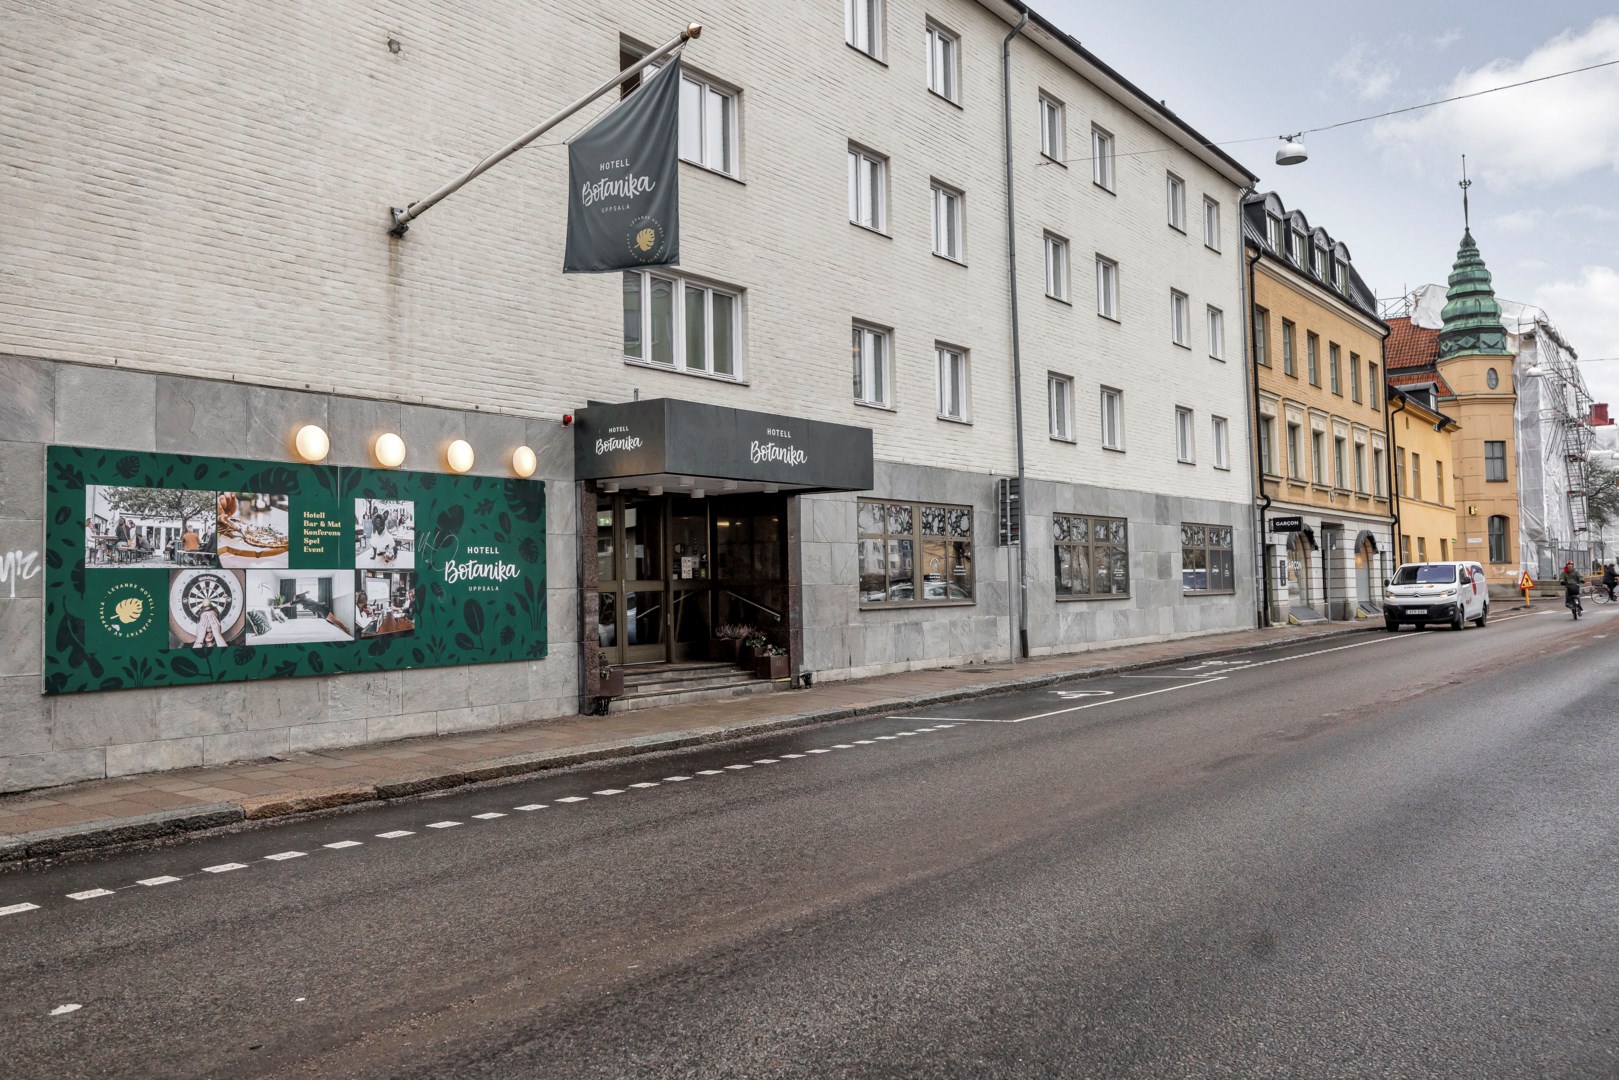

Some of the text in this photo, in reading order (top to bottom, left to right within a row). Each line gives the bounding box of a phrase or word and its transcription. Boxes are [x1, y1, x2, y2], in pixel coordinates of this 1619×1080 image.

[599, 158, 630, 171] HOTELL
[581, 173, 656, 207] Botanika
[601, 204, 630, 214] UPPSALA
[608, 425, 630, 433] HOTELL
[767, 427, 792, 438] HOTELL
[595, 435, 643, 455] Botanika
[750, 440, 808, 467] Botanika
[303, 511, 325, 519] Hotell
[327, 520, 341, 528] Mat
[303, 528, 341, 536] Konferens
[303, 537, 320, 545] Spel
[467, 546, 499, 554] HOTELL
[444, 559, 521, 584] Botanika
[107, 583, 138, 595] LEVANDE
[139, 587, 155, 610] HOTELL
[99, 601, 112, 632] UPPSALA
